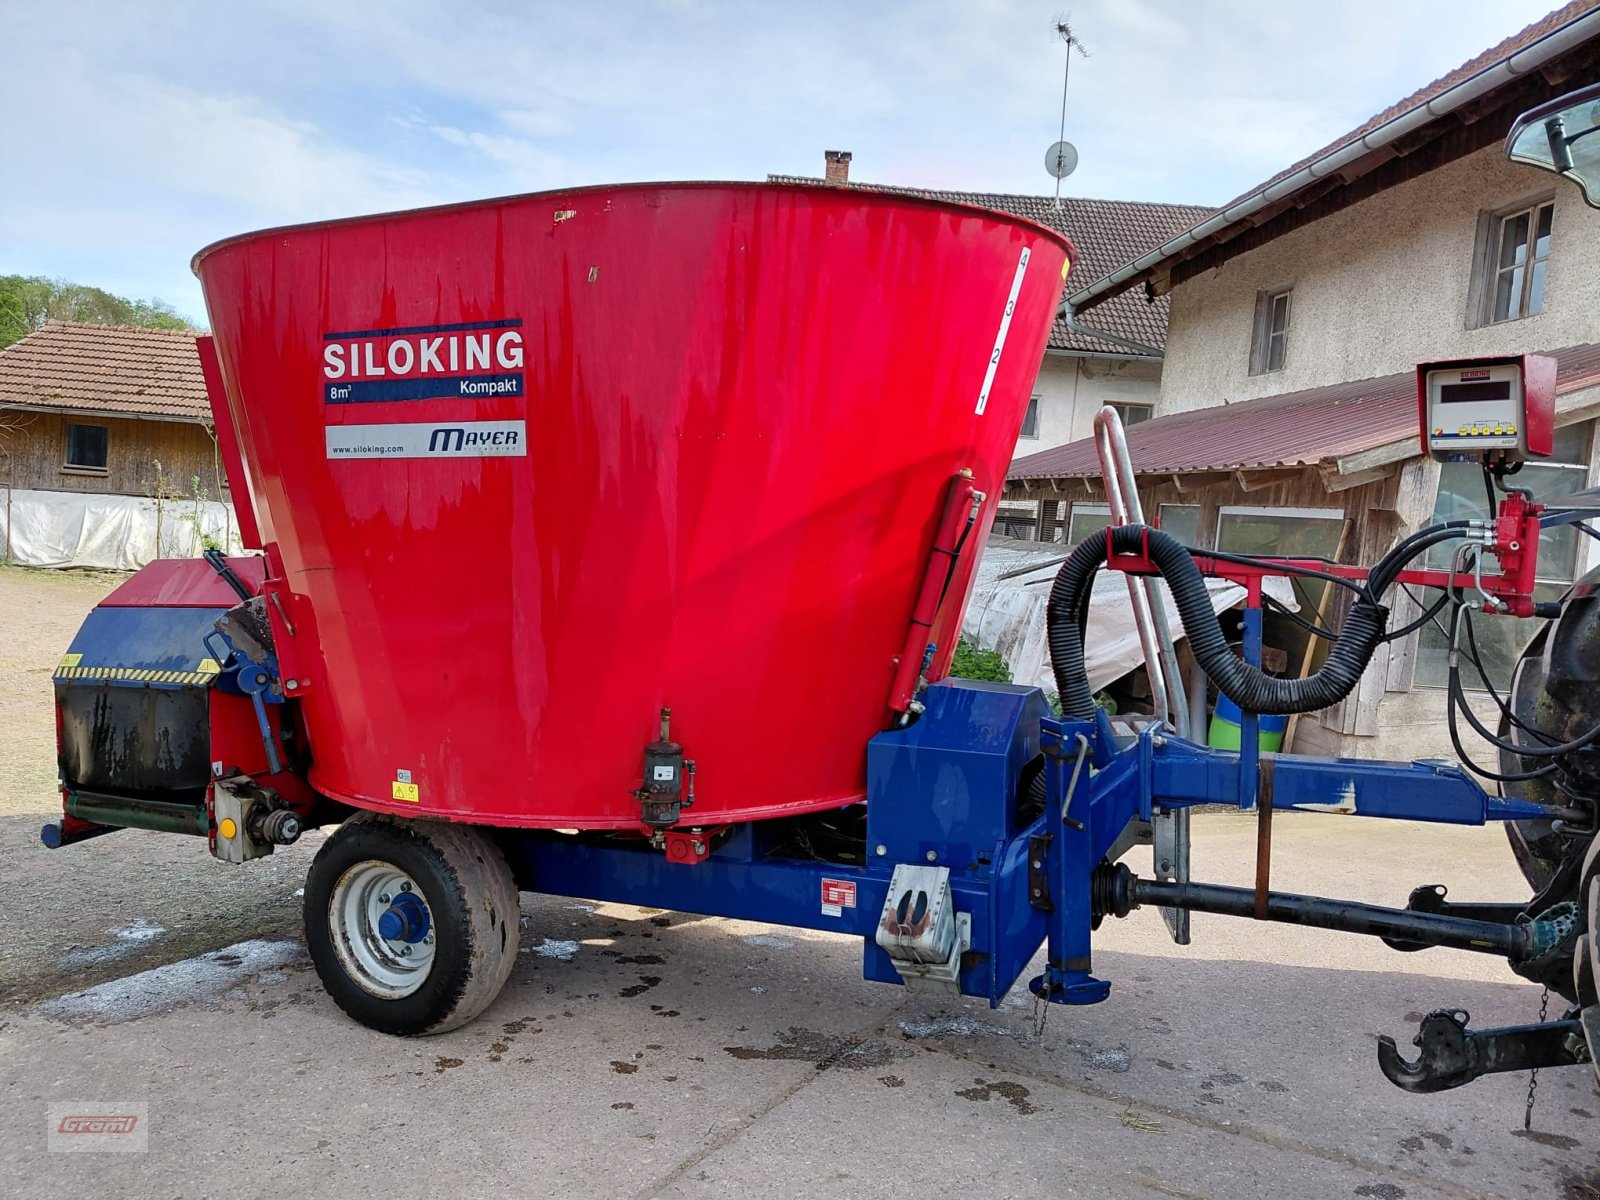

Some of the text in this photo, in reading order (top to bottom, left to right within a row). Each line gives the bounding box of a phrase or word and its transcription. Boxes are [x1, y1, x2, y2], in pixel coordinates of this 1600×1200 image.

[1020, 254, 1028, 269] 4
[1006, 301, 1014, 317] 3
[323, 331, 524, 379] SILOKING
[991, 348, 1000, 364] 2
[460, 378, 517, 396] Kompakt
[979, 394, 986, 409] 1
[428, 428, 518, 451] MAYER
[332, 445, 404, 455] www.siloking.com
